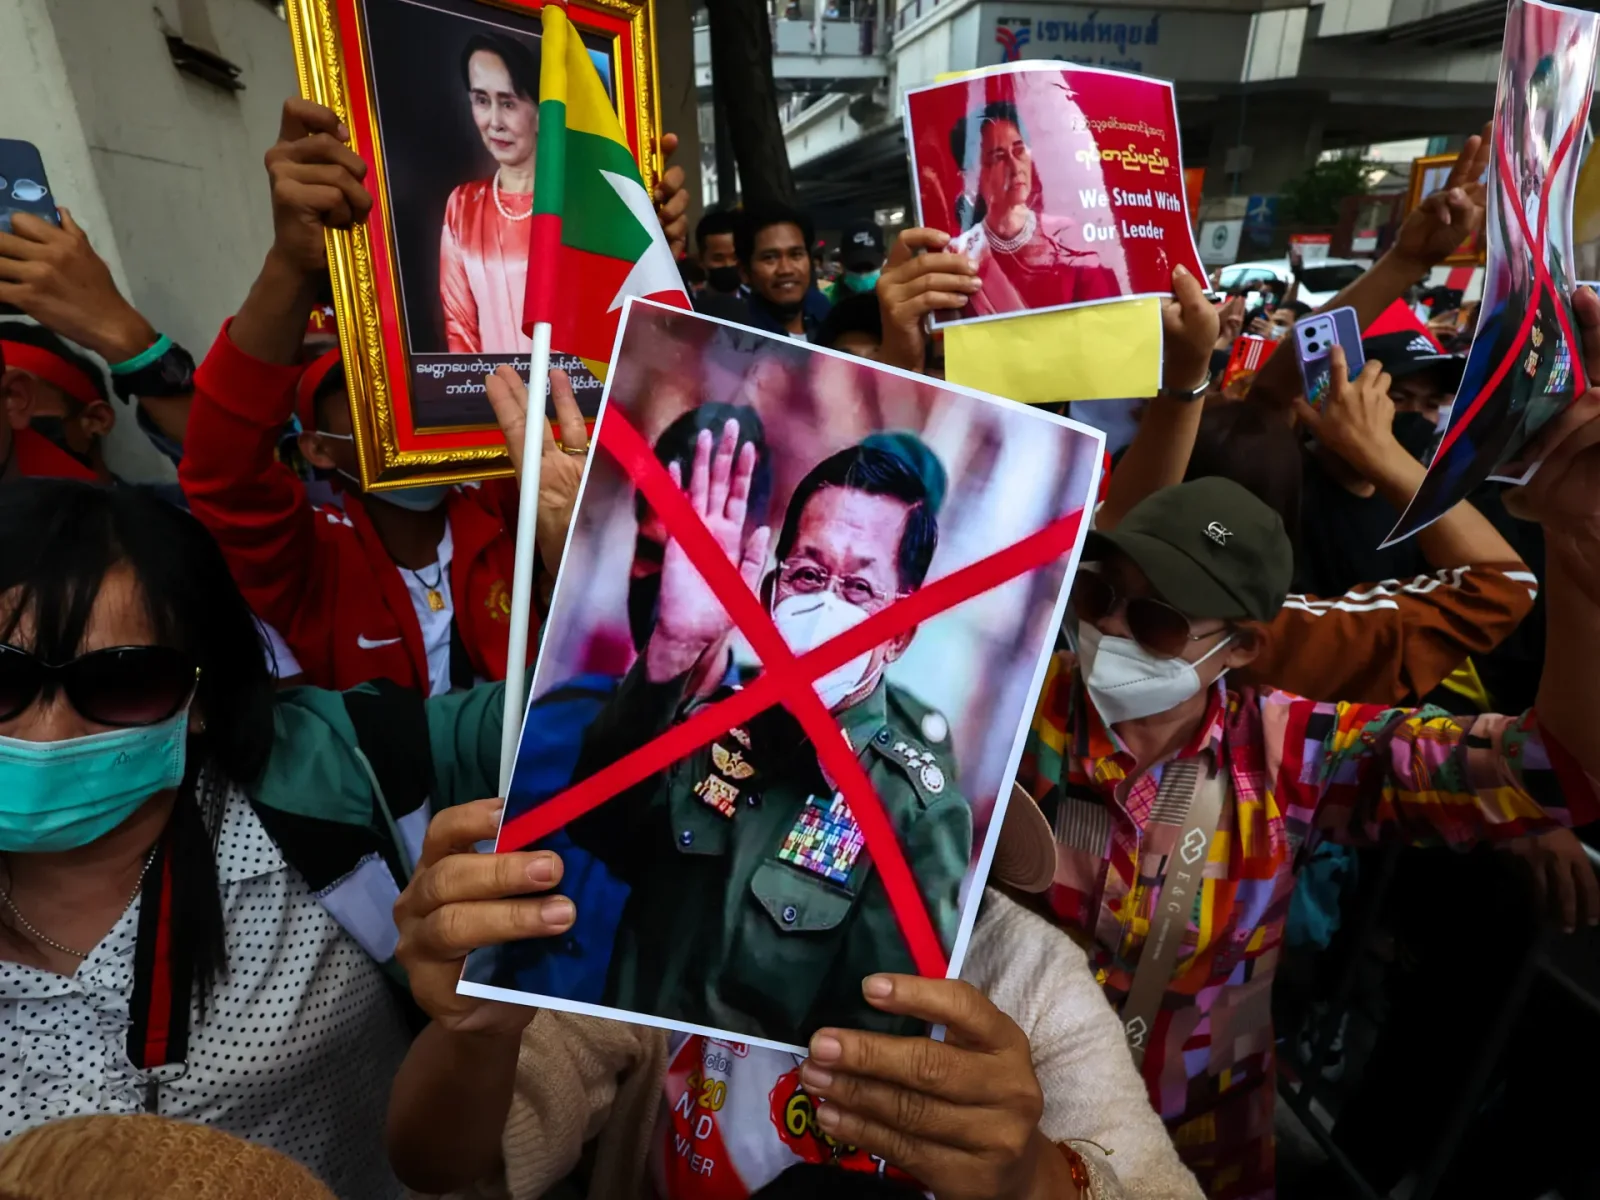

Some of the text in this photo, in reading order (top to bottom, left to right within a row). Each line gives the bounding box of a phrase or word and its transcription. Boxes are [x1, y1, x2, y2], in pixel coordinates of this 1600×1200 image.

[1079, 187, 1181, 212] We Stand With
[1082, 219, 1164, 243] Our Leader
[1177, 871, 1190, 883] E
